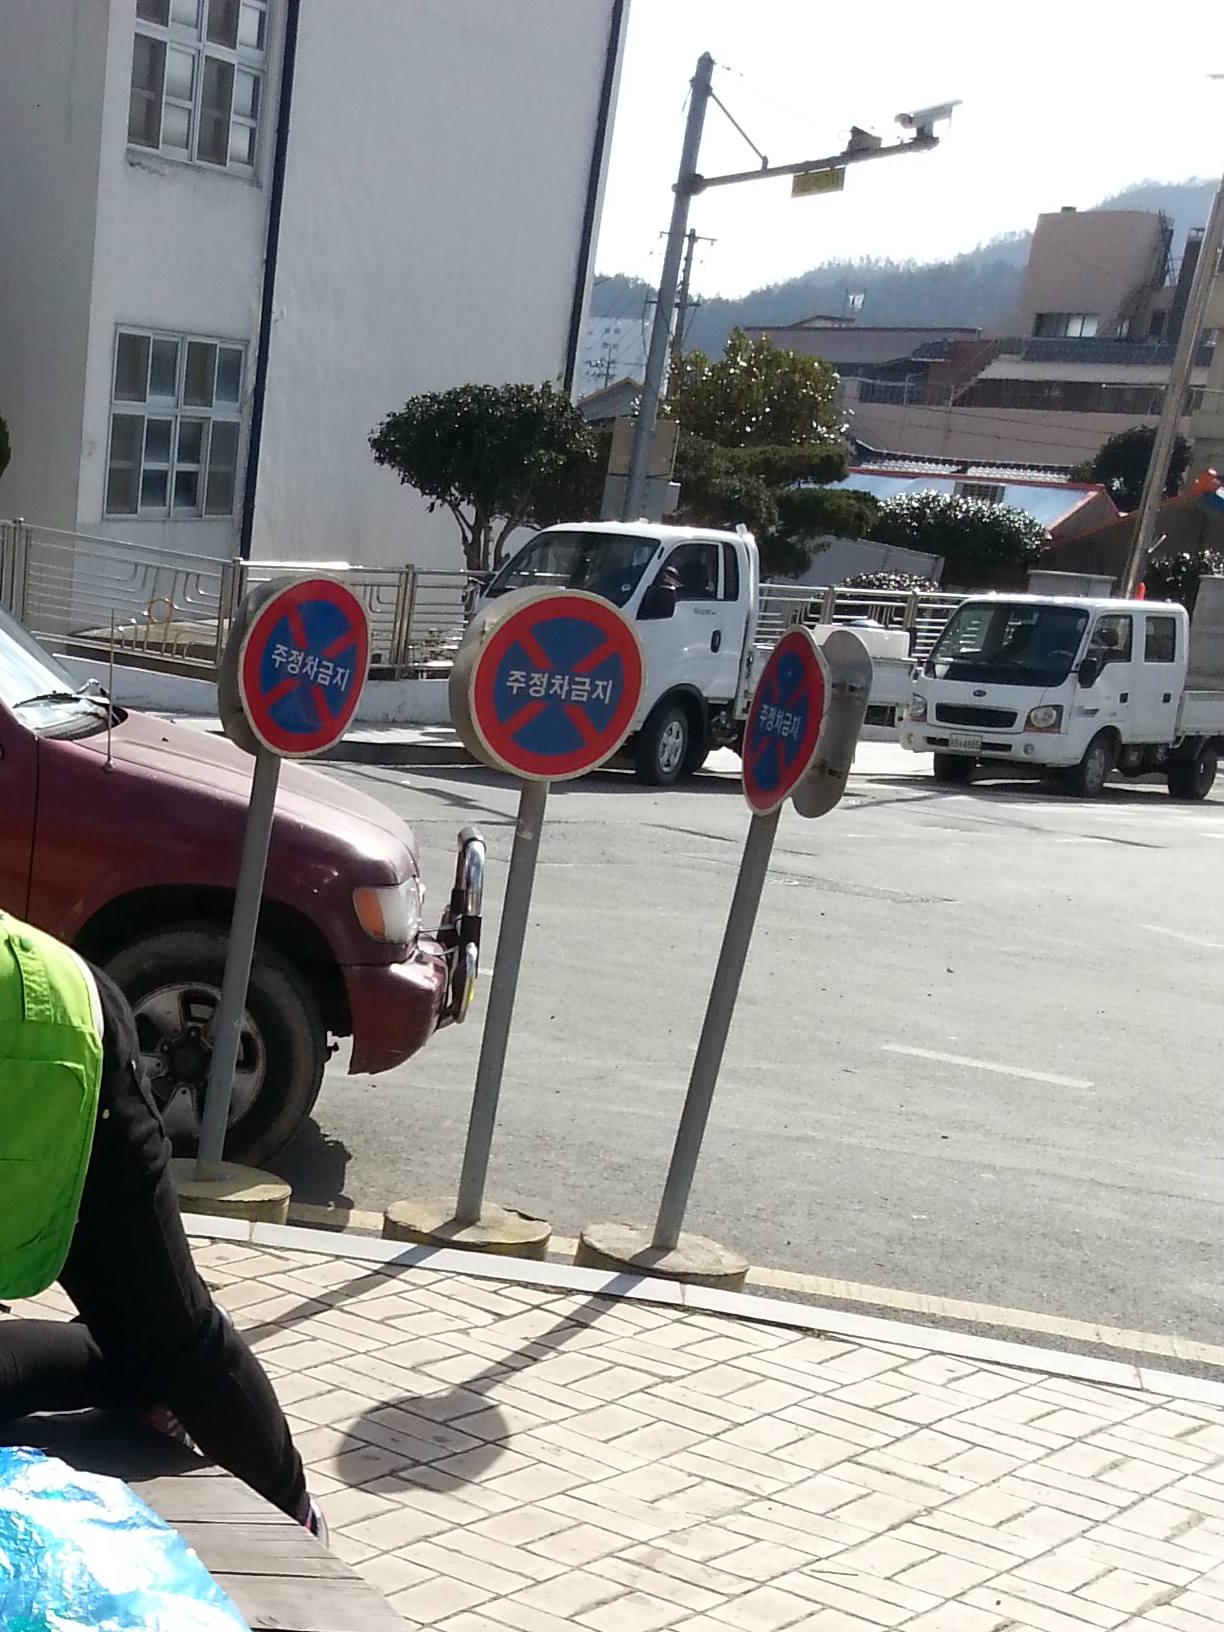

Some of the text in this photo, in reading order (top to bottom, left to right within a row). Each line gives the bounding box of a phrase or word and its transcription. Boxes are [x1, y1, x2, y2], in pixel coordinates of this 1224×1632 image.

[271, 643, 350, 692] 주정차금지
[505, 669, 613, 705] 주정차금지
[759, 703, 802, 741] 주정차금지
